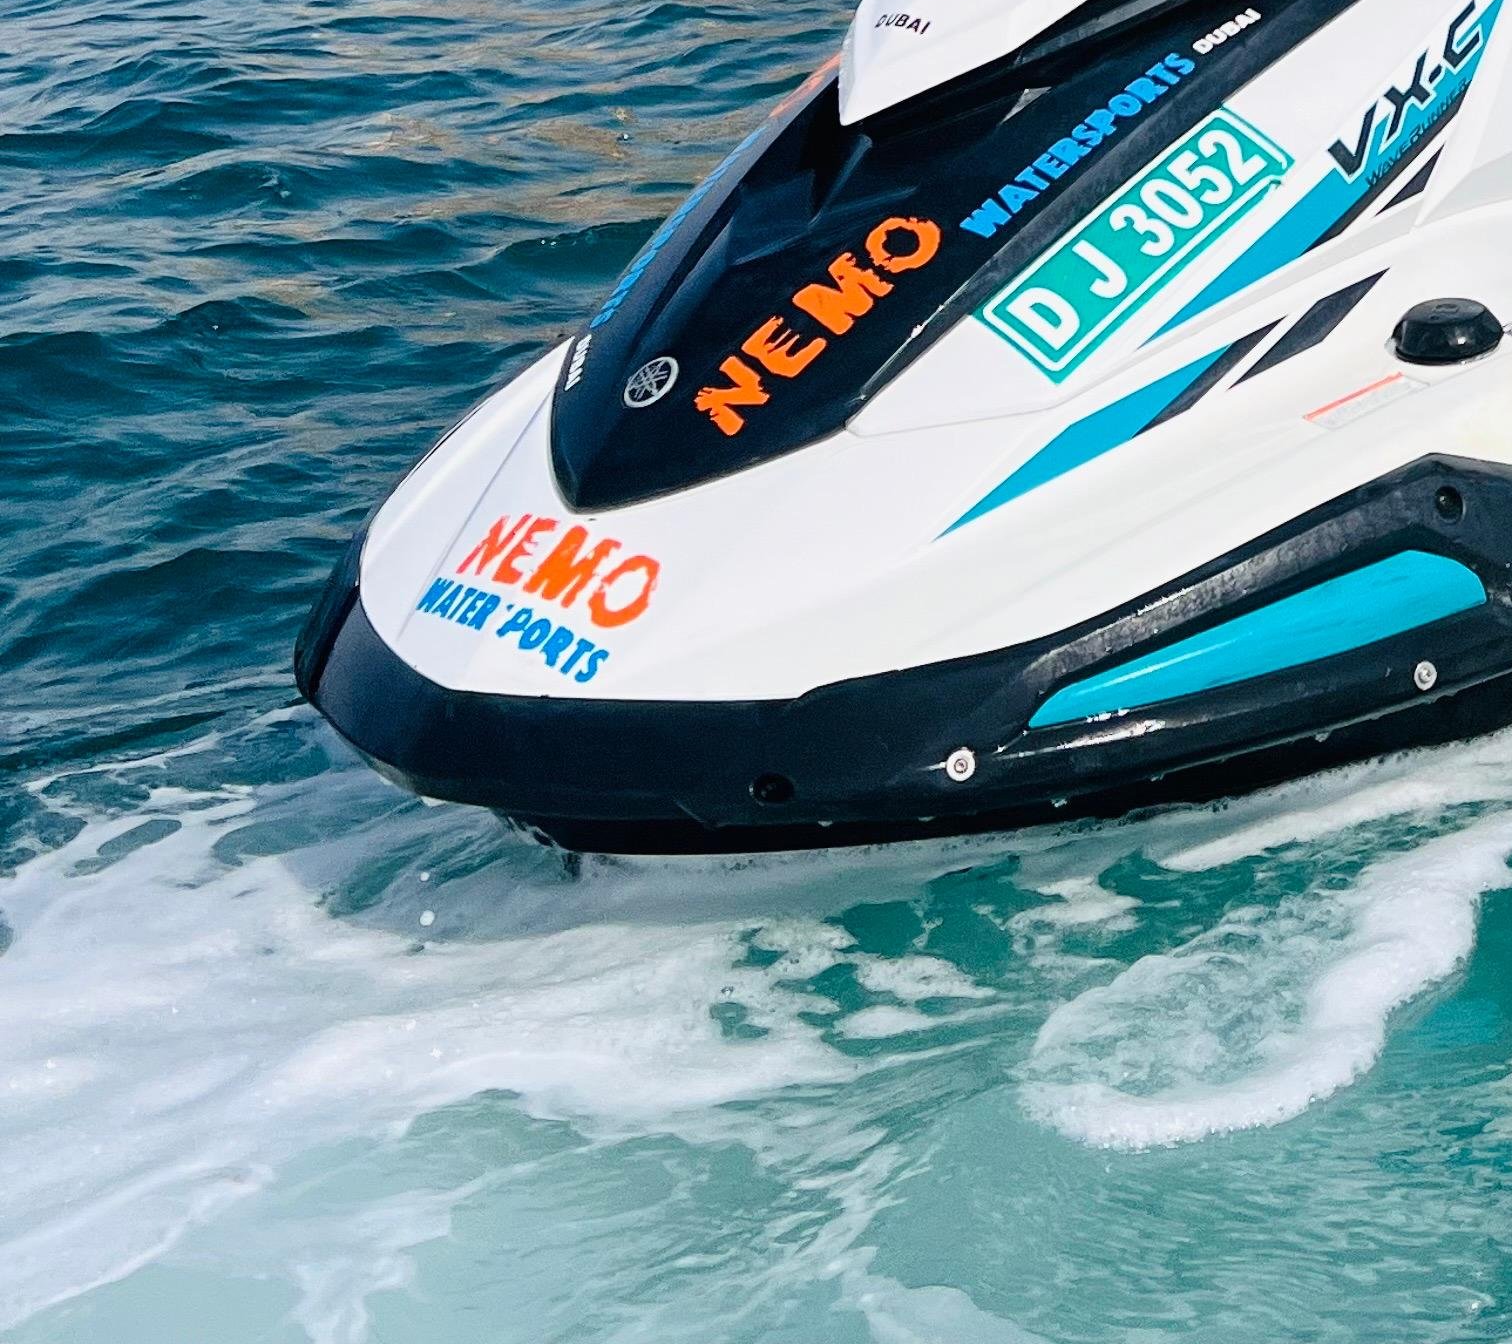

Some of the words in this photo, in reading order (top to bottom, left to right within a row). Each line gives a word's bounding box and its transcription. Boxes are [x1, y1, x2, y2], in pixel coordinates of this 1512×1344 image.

[874, 12, 932, 36] DUBAI
[959, 51, 1197, 240] WATERSPORTS
[1192, 8, 1262, 56] DUBAI
[695, 217, 940, 436] NEMO
[1006, 285, 1081, 351] D
[1072, 240, 1128, 299] J
[1110, 129, 1268, 258] 3052
[456, 514, 661, 629] NEMO
